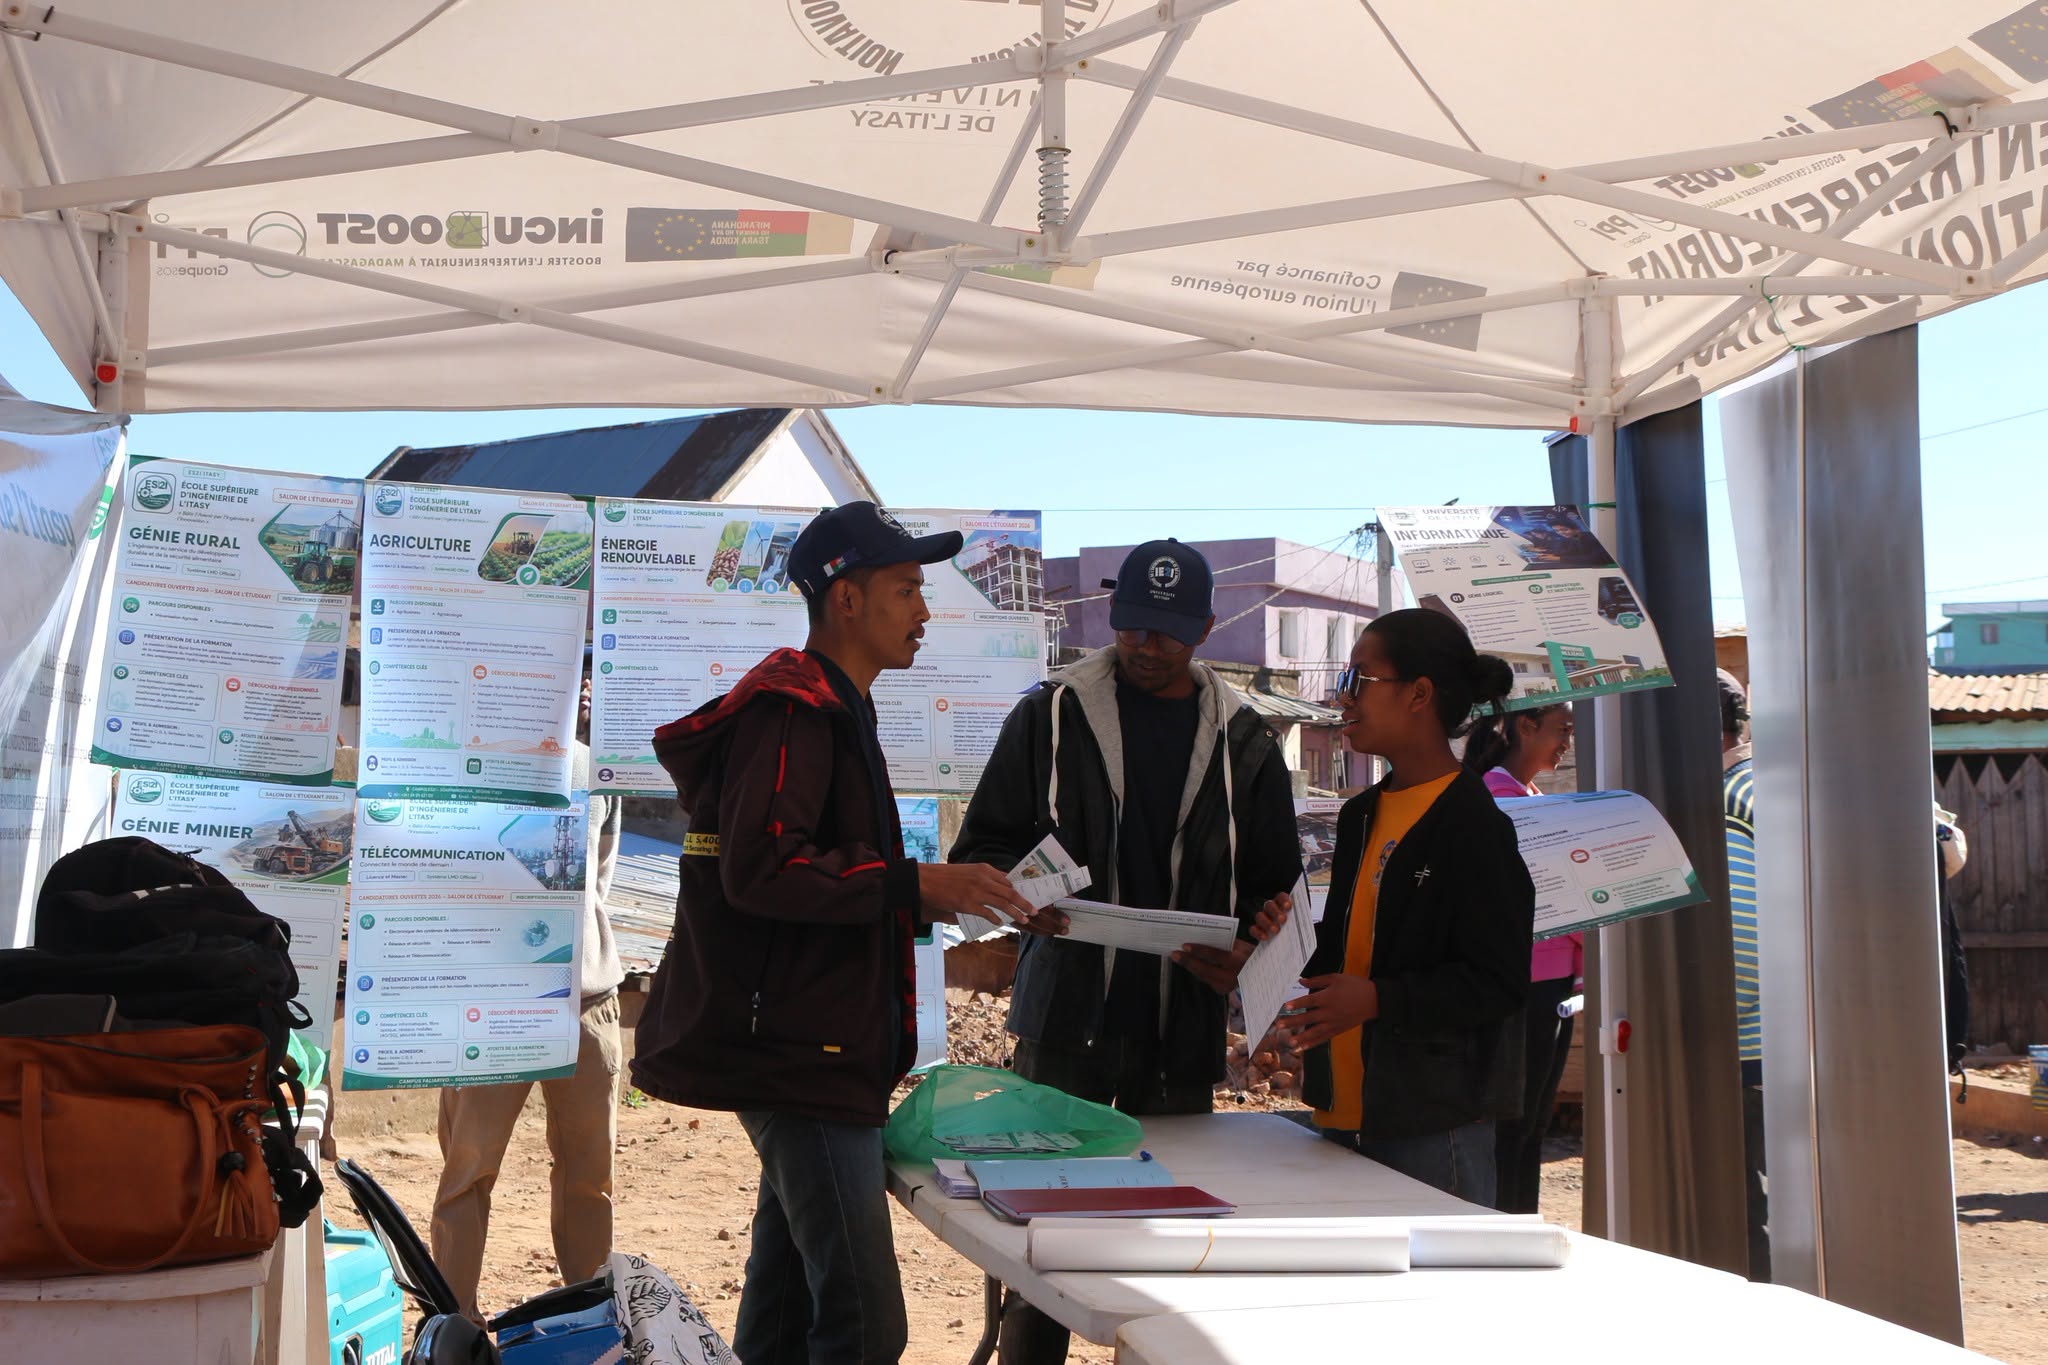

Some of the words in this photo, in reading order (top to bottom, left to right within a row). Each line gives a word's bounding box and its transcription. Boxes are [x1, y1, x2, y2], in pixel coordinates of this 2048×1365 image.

[181, 481, 208, 491] ÉCOLE
[210, 484, 259, 496] SUPÉRIEURE
[180, 491, 235, 503] D'INGÉNIERIE
[237, 496, 248, 504] DE
[278, 493, 298, 501] SALON
[299, 494, 309, 502] DE
[310, 494, 339, 505] L'ÉTUDIANT
[410, 496, 430, 504] ÉCOLE
[431, 497, 469, 507] SUPÉRIEURE
[179, 501, 210, 510] L'ITASY
[409, 504, 449, 513] D'INGÉNIERIE
[130, 526, 180, 544] GÉNIE
[185, 532, 240, 550] RURAL
[1393, 528, 1510, 541] INFORMATIQUE
[370, 533, 471, 552] AGRICULTURE
[601, 535, 657, 551] ÉNERGIE
[601, 552, 696, 565] RENOUVELABLE
[126, 579, 167, 589] CANDIDATURES
[167, 583, 195, 592] OUVERTES
[241, 591, 272, 600] L'ÉTUDIANT
[1530, 585, 1541, 593] 02
[148, 600, 176, 608] PARCOURS
[177, 603, 210, 612] DISPONIBLES
[144, 632, 184, 642] PRÉSENTATION
[201, 639, 232, 647] FORMATION
[170, 781, 194, 789] ÉCOLE
[195, 782, 240, 791] SUPÉRIEURE
[170, 788, 218, 797] D'INGÉNIERIE
[409, 804, 457, 813] D'INGÉNIERIE
[121, 816, 179, 835] GÉNIE
[185, 822, 253, 840] MINIER
[360, 845, 505, 861] TÉLÉCOMMUNICATION
[381, 975, 419, 983] PRÉSENTATION
